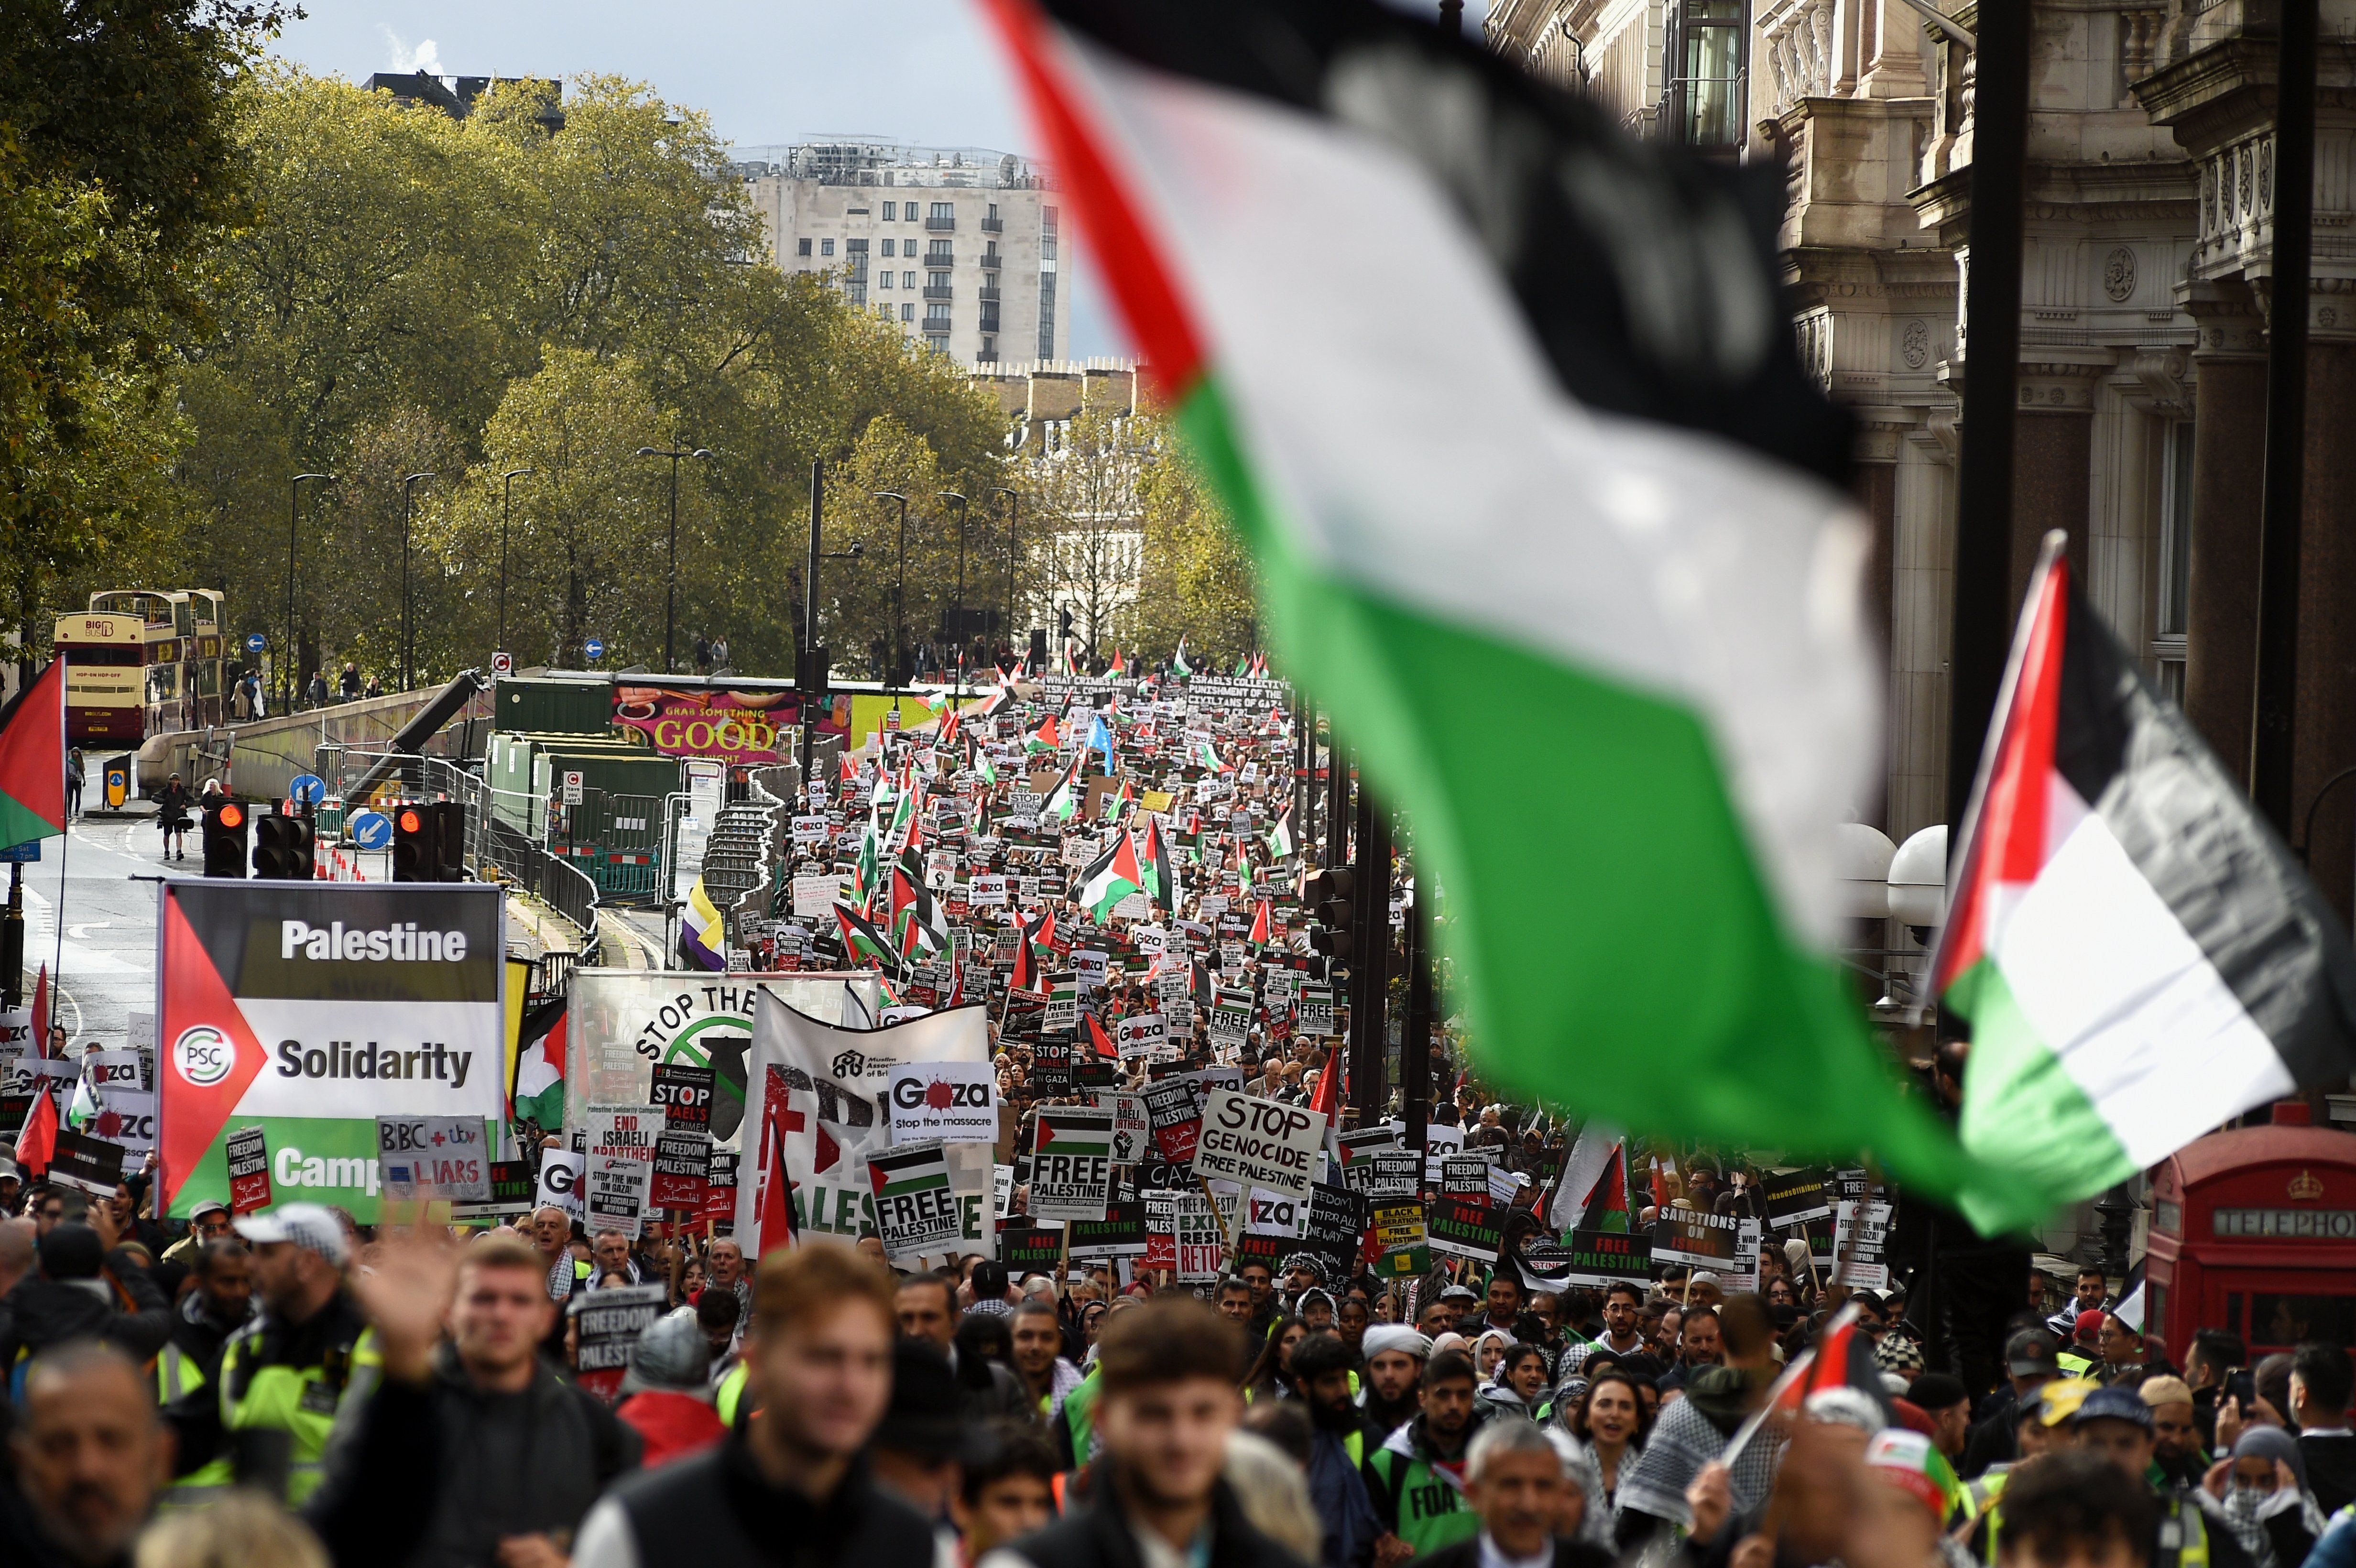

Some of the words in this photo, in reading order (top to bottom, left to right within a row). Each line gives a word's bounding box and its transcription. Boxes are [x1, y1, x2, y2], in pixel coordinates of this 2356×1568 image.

[1046, 675, 1071, 685] WHAT
[1074, 676, 1110, 686] CRIMES
[1113, 677, 1137, 687] MUST
[1189, 675, 1232, 686] ISRAEL'S
[1233, 678, 1291, 690] COLLECTIVE
[1045, 695, 1062, 703] FOR
[1189, 685, 1248, 697] PUNISHMENT
[1265, 690, 1282, 699] THE
[1188, 695, 1242, 707] CIVILIANS
[1244, 699, 1256, 707] OF
[666, 707, 695, 716] GRAB
[699, 708, 765, 718] SOMETHING
[654, 720, 774, 751] GOOD
[1011, 794, 1040, 802] STOP
[282, 920, 466, 962] Palestine
[1295, 959, 1307, 969] NO
[915, 971, 935, 980] FREEDOM
[912, 980, 935, 988] PALESTINE
[1301, 1004, 1332, 1018] FREE
[635, 992, 694, 1061] STOP
[701, 986, 755, 1017] THE
[1212, 1010, 1248, 1028] FREE
[1211, 1023, 1246, 1035] PALESTINE
[186, 1047, 221, 1066] PSC
[1036, 1046, 1069, 1058] STOP
[276, 1039, 472, 1089] Solidarity
[1036, 1058, 1068, 1067] ISRAEL'S
[1046, 1075, 1068, 1084] GAZA
[654, 1083, 709, 1106] STOP
[893, 1078, 990, 1110] Gza
[1147, 1087, 1189, 1109] FREEDOM
[1117, 1099, 1132, 1109] END
[1039, 1108, 1062, 1116] Palestine
[1088, 1110, 1113, 1118] Campaign
[1152, 1105, 1197, 1128] PALESTINE
[1217, 1098, 1310, 1141] STOP
[614, 1116, 637, 1131] END
[673, 1121, 705, 1132] CRIMES
[896, 1119, 920, 1129] Stop
[923, 1118, 940, 1127] the
[943, 1118, 992, 1126] massacre
[382, 1123, 425, 1151] BBC
[448, 1124, 475, 1144] itv
[602, 1131, 648, 1147] ISRAELI
[1165, 1125, 1195, 1142] الحرية
[229, 1137, 262, 1158] FREEDOM
[592, 1146, 656, 1162] APARTHEI
[660, 1141, 706, 1157] FREEDOM
[890, 1147, 914, 1156] Solidarity
[915, 1142, 940, 1151] Campaign
[1203, 1129, 1310, 1171] GENOCIDE
[229, 1156, 266, 1178] PALESTINE
[414, 1160, 478, 1185] LIARS
[655, 1159, 707, 1176] PALESTINE
[1033, 1156, 1106, 1183] FREE
[1200, 1153, 1237, 1173] FREE
[1239, 1162, 1307, 1191] PALESTINE
[1376, 1161, 1416, 1172] FREEDOM
[1447, 1164, 1485, 1175] FREEDOM
[237, 1177, 262, 1193] الحرية
[592, 1171, 610, 1181] STOP
[612, 1174, 624, 1184] THE
[627, 1176, 642, 1186] WAR
[662, 1178, 696, 1191] الحرية
[1375, 1177, 1419, 1189] PALESTINE
[600, 1182, 610, 1192] ON
[612, 1184, 632, 1195] GAZA!
[1031, 1184, 1105, 1198] PALESTINE
[1445, 1181, 1488, 1192] PALESTINE
[235, 1188, 266, 1208] لفلسطين
[592, 1194, 602, 1203] FOR
[610, 1196, 638, 1207] SOCIALIST
[656, 1191, 699, 1204] لفلسطين
[602, 1204, 627, 1215] INTIFADA
[875, 1187, 955, 1227] FREE
[1382, 1208, 1413, 1218] BLACK
[1376, 1218, 1422, 1227] LIBERATION:
[1454, 1207, 1484, 1225] FREE
[1660, 1207, 1736, 1230] SANCTIONS
[881, 1215, 958, 1241] PALESTINE
[1077, 1222, 1137, 1235] PALESTINE
[1388, 1227, 1412, 1236] FREE
[1432, 1217, 1499, 1244] PALESTINE
[2220, 1210, 2356, 1238] TELEPHO
[899, 1237, 921, 1247] ISRAELI
[923, 1230, 958, 1241] OCCUPATION
[1379, 1235, 1422, 1244] PALESTINE!
[1688, 1225, 1705, 1240] ON
[1742, 1235, 1757, 1244] WAR
[1029, 1236, 1055, 1248] FREE
[1244, 1239, 1276, 1255] FREE
[1596, 1238, 1629, 1253] FREE
[1574, 1252, 1648, 1271] PALESTINE
[1410, 1484, 1458, 1521] FOA
